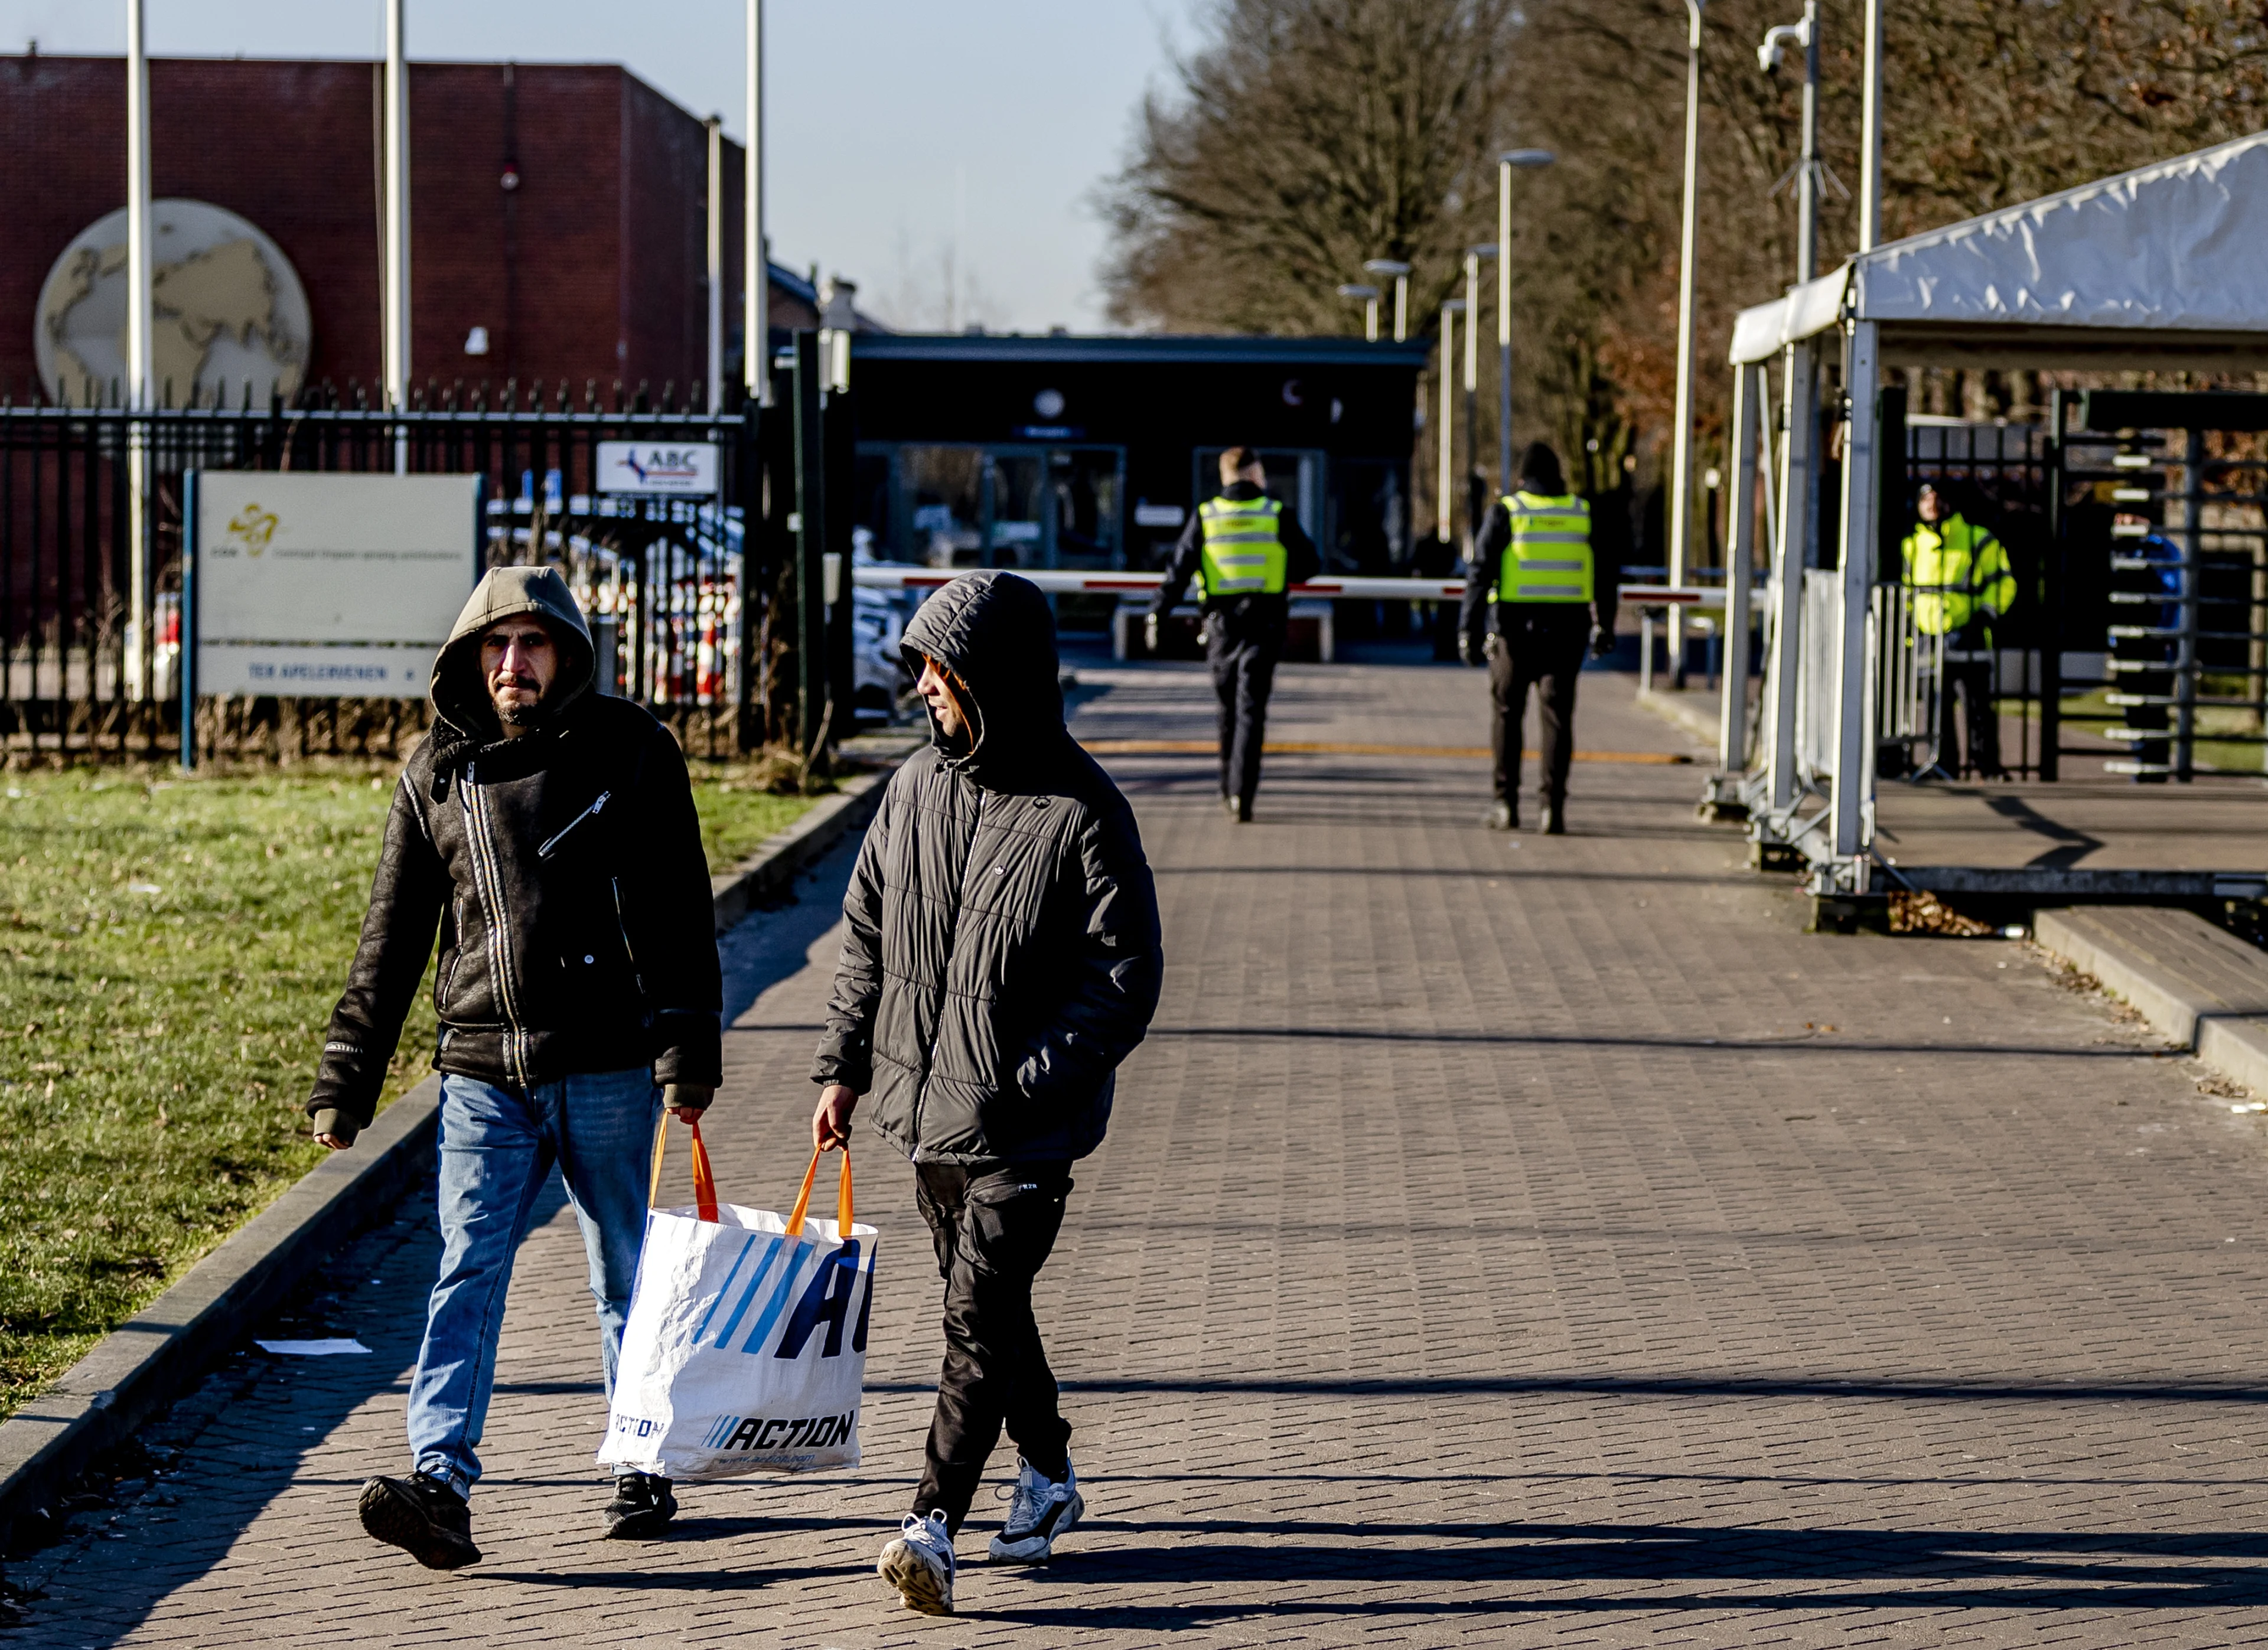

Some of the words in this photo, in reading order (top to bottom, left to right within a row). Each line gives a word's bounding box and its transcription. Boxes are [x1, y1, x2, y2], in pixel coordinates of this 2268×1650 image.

[649, 449, 697, 472] ABC
[724, 1410, 855, 1450] ACTION
[719, 1453, 816, 1464] www.action.com
